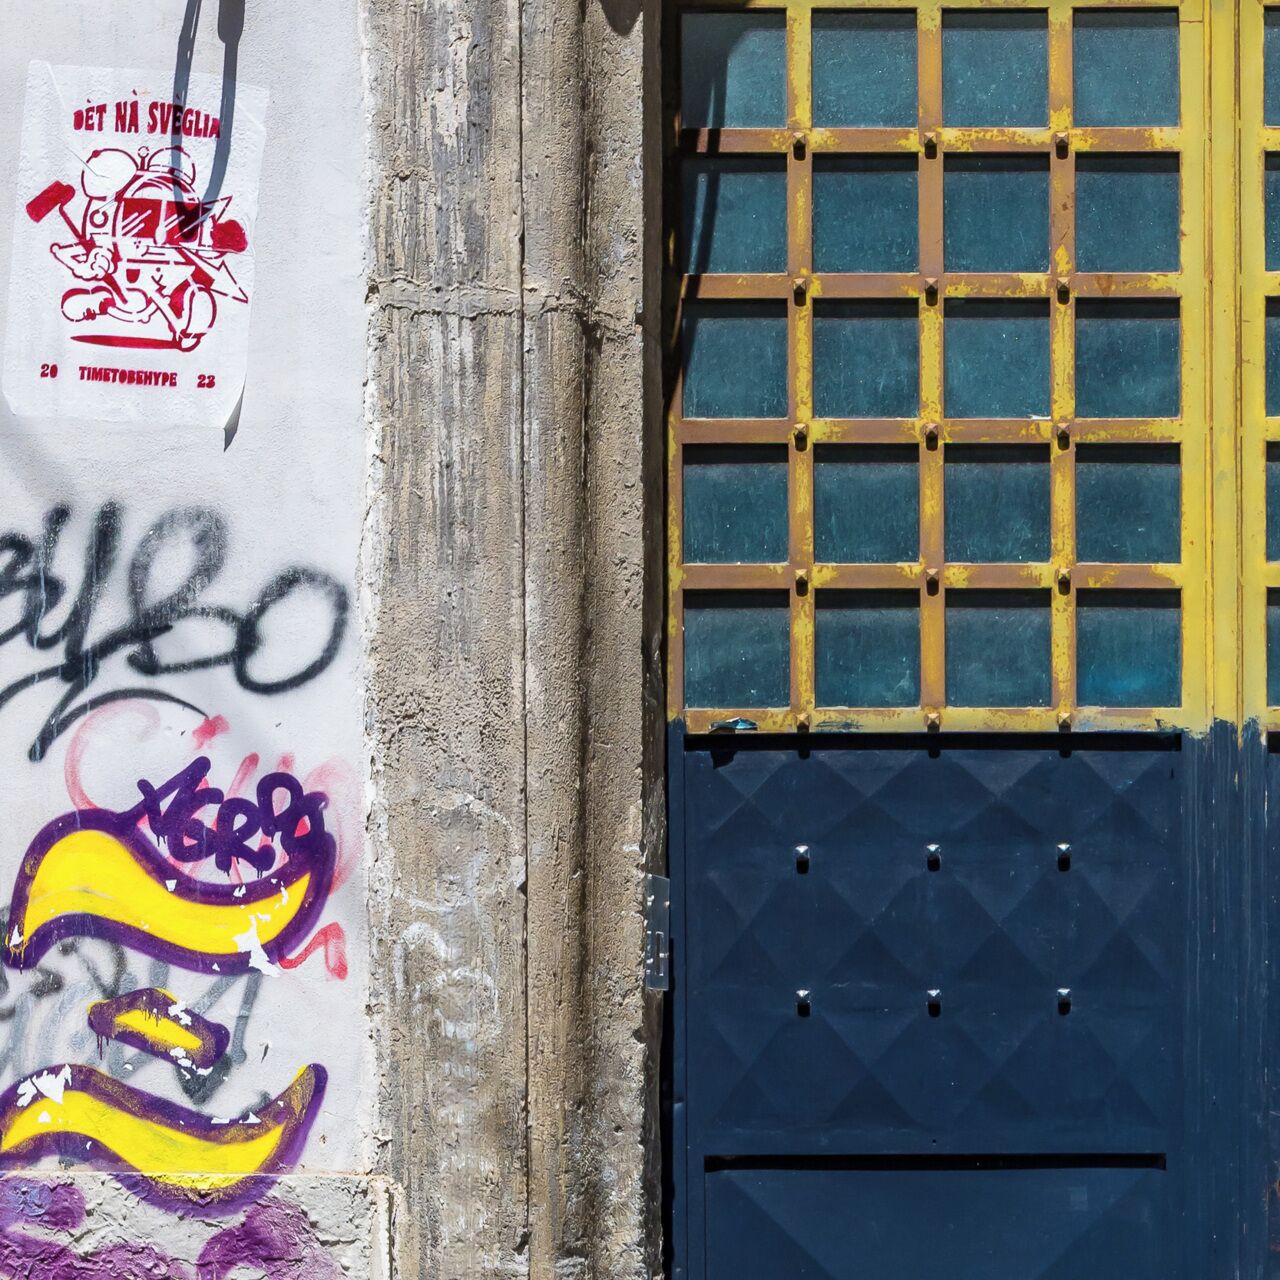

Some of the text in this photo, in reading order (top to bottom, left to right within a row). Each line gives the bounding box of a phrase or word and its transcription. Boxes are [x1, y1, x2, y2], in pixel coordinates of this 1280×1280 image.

[114, 89, 139, 134] NÀ
[40, 363, 58, 378] 20
[78, 366, 178, 387] TIMETOBEHYPE
